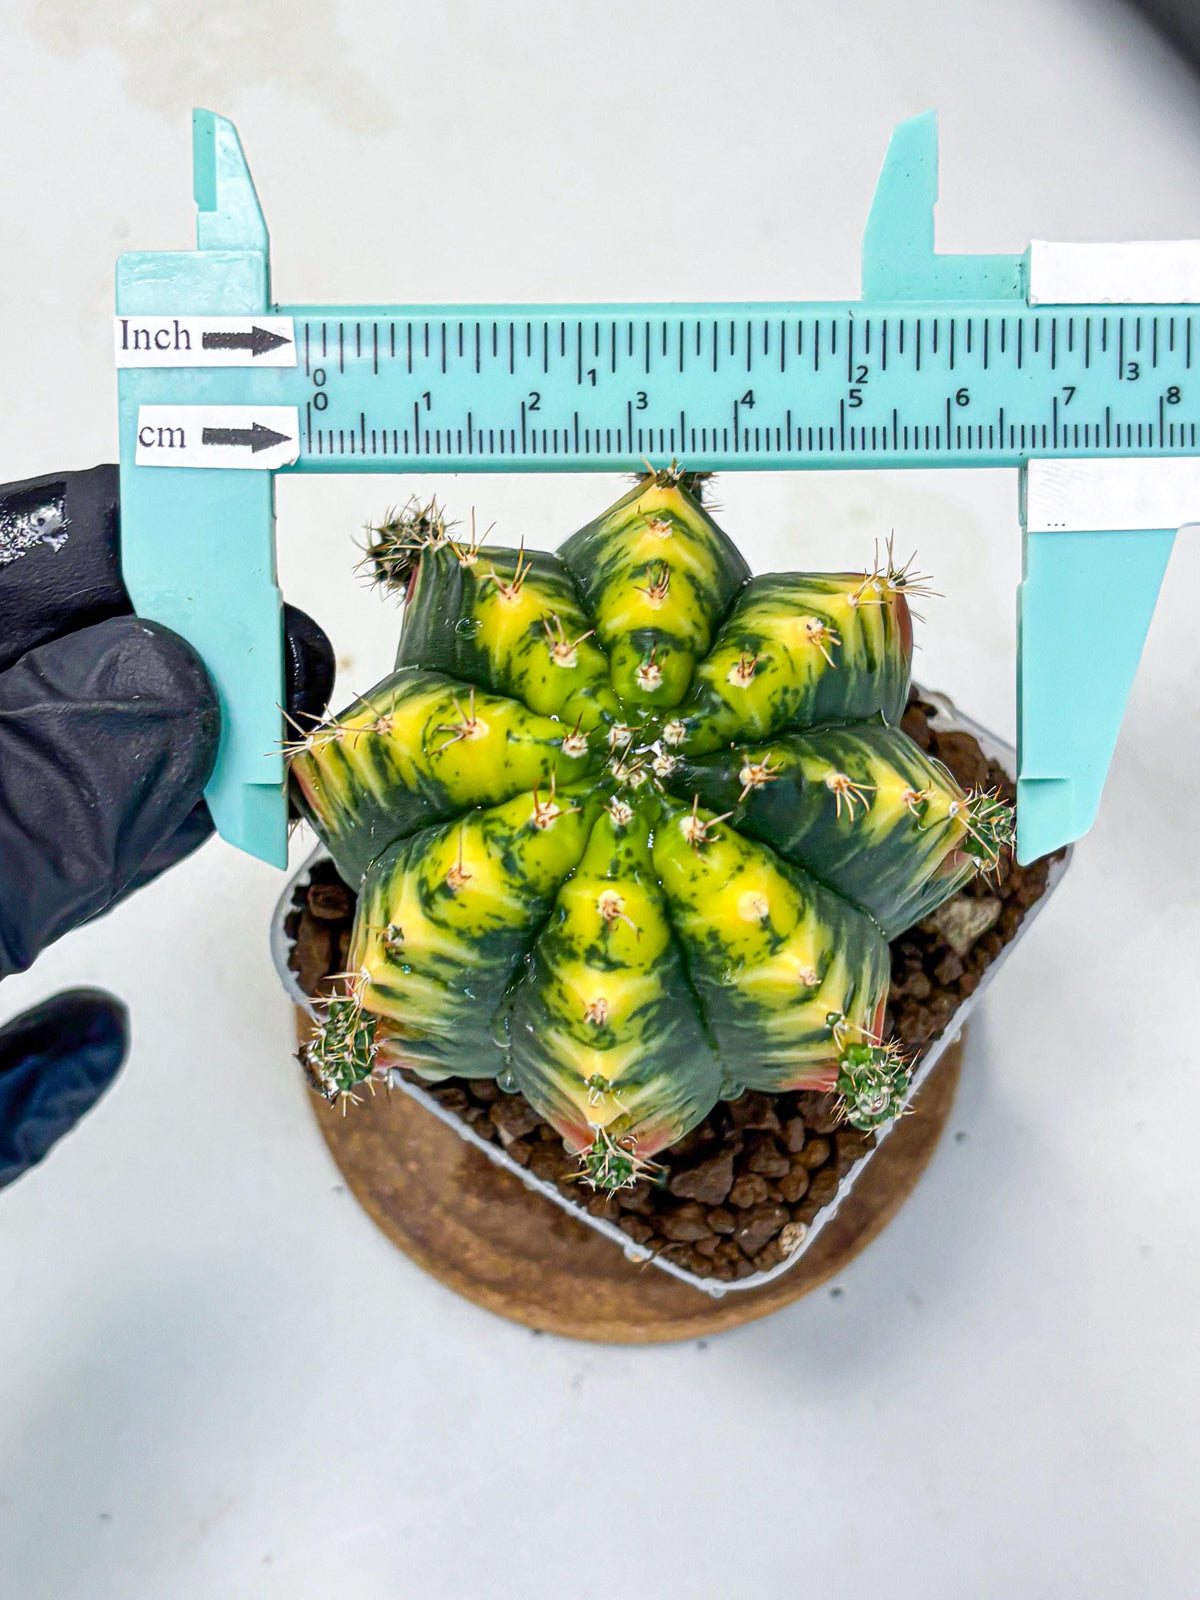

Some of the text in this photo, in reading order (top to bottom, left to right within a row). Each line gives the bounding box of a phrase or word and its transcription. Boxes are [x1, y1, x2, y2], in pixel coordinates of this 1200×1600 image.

[121, 319, 192, 350] Inch
[312, 361, 1140, 388] 0 1 2 3
[312, 385, 1182, 412] 0 1 2 3 4 5 6 7 8
[138, 426, 186, 449] cm
